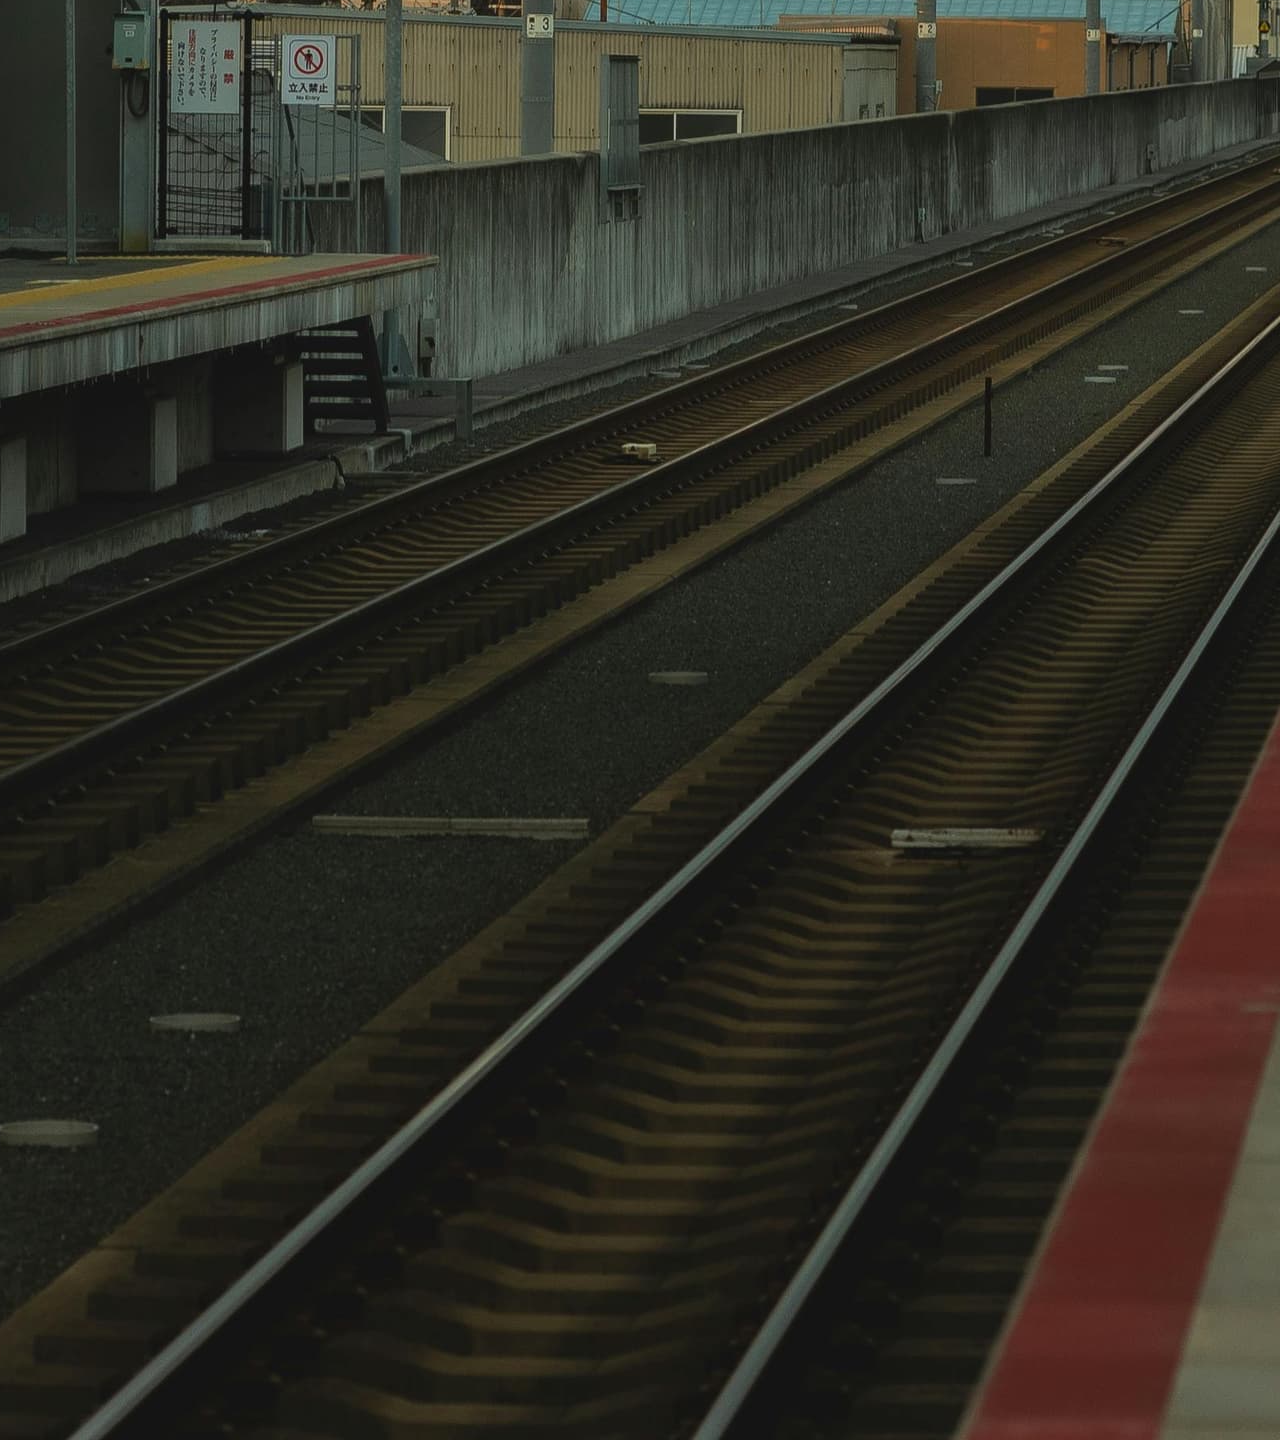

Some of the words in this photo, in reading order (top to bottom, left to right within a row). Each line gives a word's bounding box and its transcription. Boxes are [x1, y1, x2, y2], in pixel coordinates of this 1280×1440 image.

[542, 17, 550, 31] 3
[927, 24, 933, 34] 2
[288, 82, 329, 94] 立入禁止
